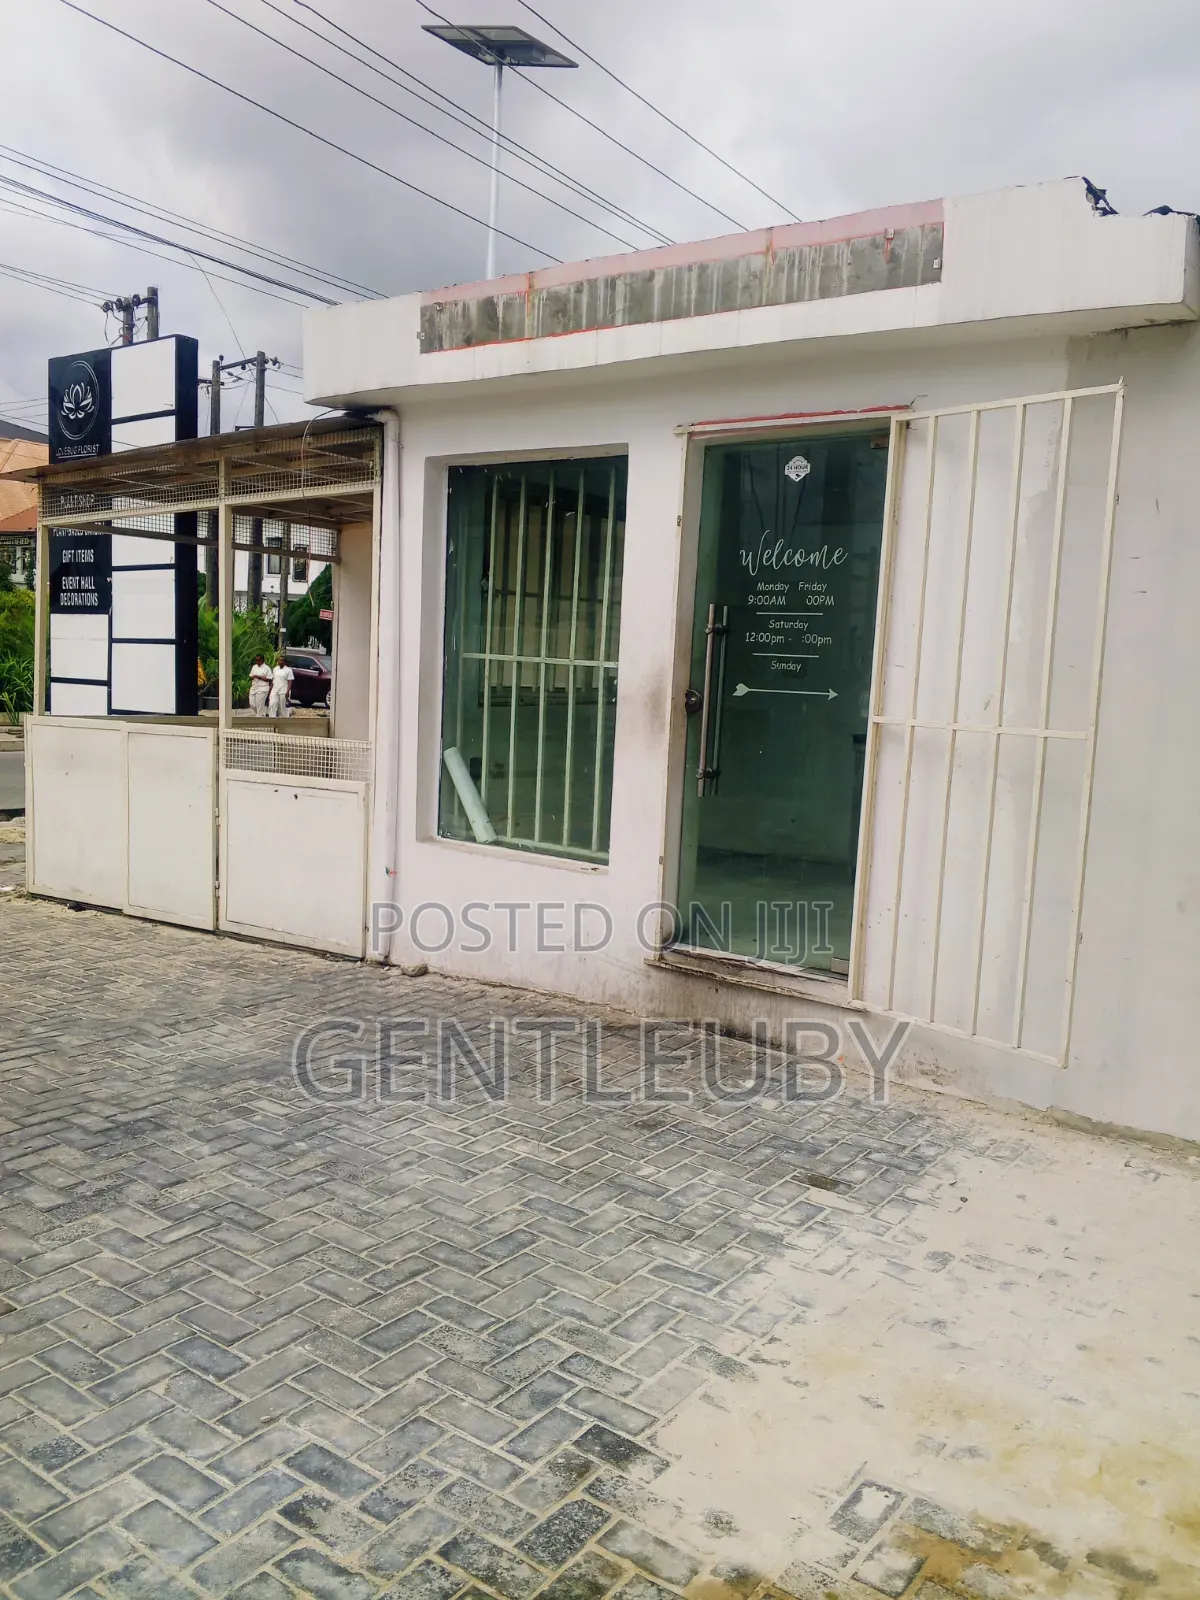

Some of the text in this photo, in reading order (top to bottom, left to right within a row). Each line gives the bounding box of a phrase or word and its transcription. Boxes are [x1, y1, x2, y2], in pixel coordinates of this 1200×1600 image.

[78, 444, 99, 454] FLORIST
[62, 549, 94, 563] GIFT ITEMS
[740, 530, 848, 575] Welcome
[62, 575, 95, 590] EVENT HALL
[756, 582, 827, 593] Monday Friday
[60, 592, 98, 606] DECORATIONS
[748, 595, 786, 605] 9:00AM
[768, 620, 809, 631] Saturday
[745, 632, 784, 645] 12:00pm
[770, 661, 801, 672] Sunday
